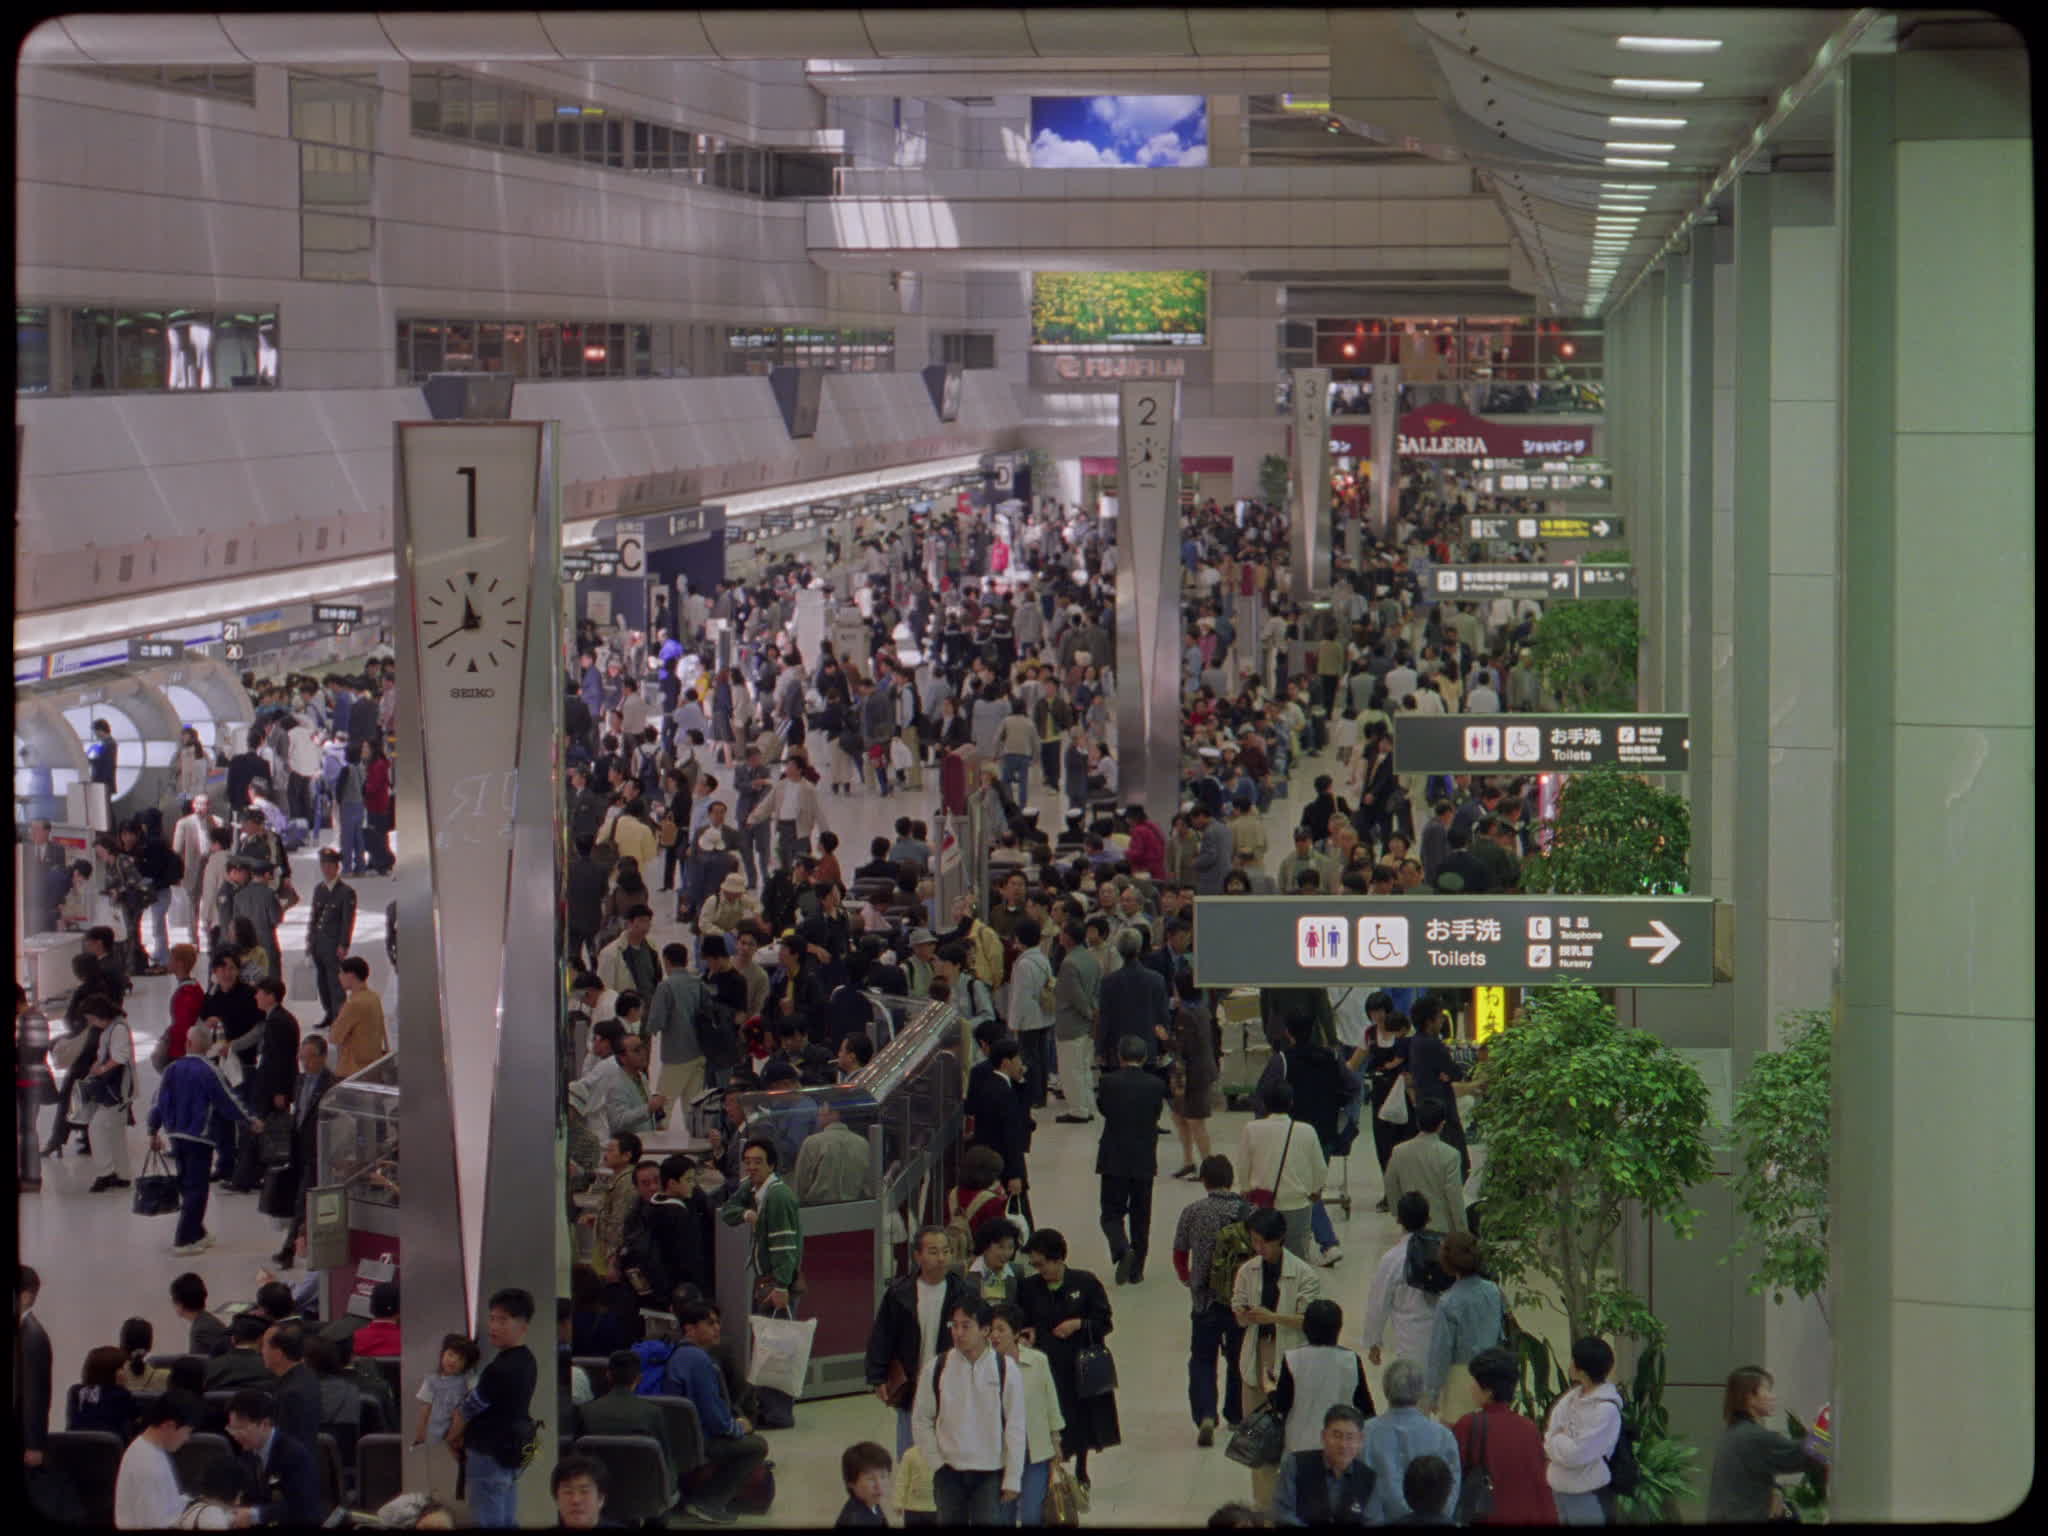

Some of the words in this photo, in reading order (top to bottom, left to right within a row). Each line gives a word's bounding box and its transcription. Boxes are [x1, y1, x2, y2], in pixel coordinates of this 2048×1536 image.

[1085, 358, 1184, 377] FUJIFILM
[1138, 397, 1157, 425] 2
[996, 466, 1009, 485] D
[457, 467, 476, 537] 1
[621, 539, 641, 572] C
[450, 688, 495, 698] SEIKO
[1551, 727, 1602, 745] お手洗
[1552, 748, 1592, 761] Toilets
[1426, 918, 1501, 942] お手洗
[1427, 950, 1487, 967] Toilets
[1559, 959, 1593, 969] Nursery
